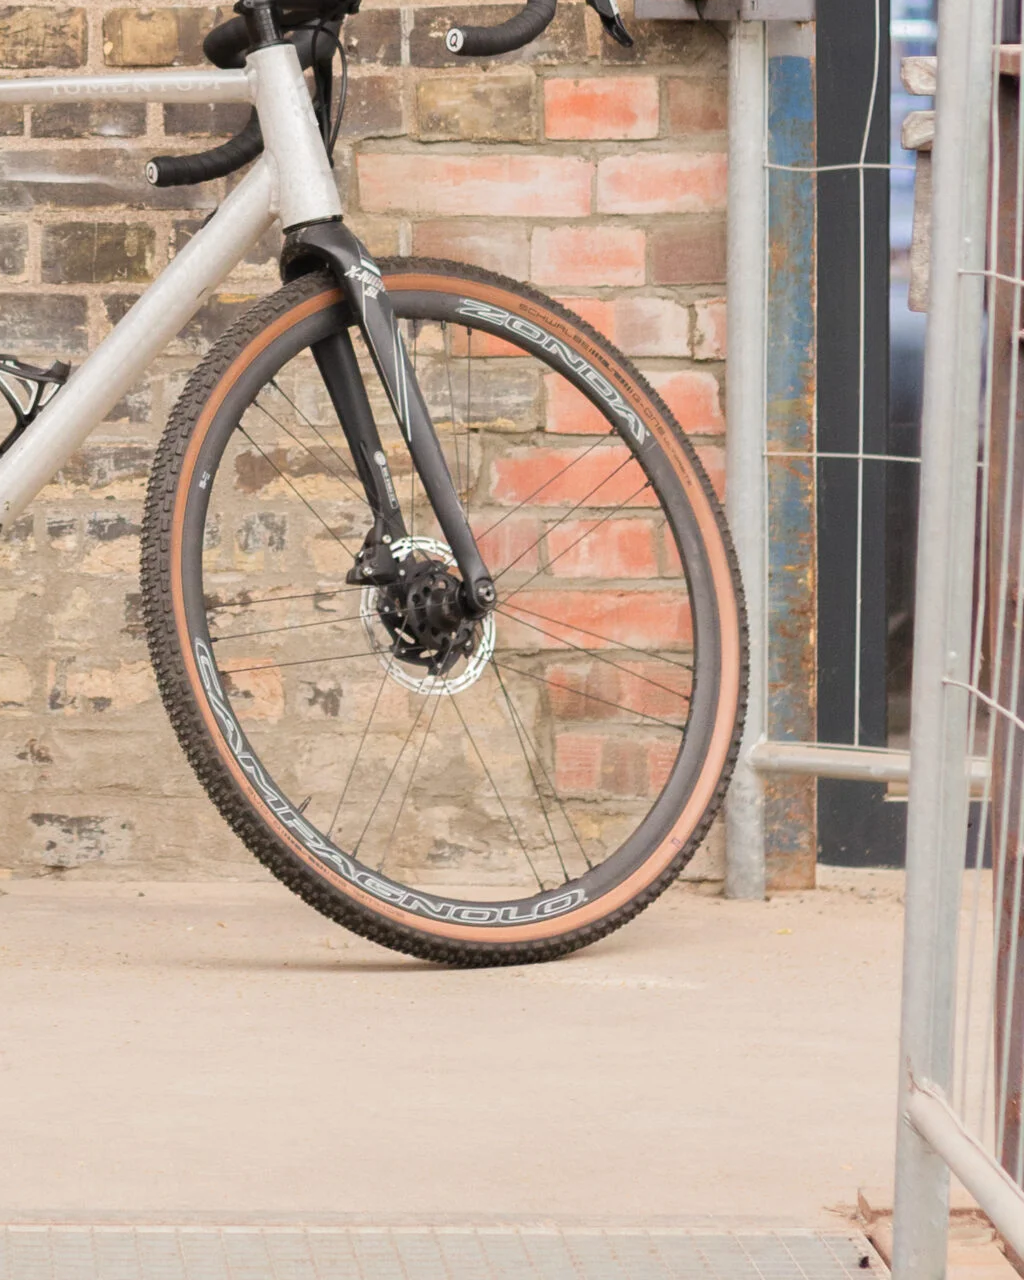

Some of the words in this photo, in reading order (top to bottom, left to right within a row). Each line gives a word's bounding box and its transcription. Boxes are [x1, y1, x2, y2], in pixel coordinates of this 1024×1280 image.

[456, 298, 646, 445] ZONDA
[519, 303, 589, 352] SCHWALBE
[195, 638, 585, 923] CAMPAGNOLO
